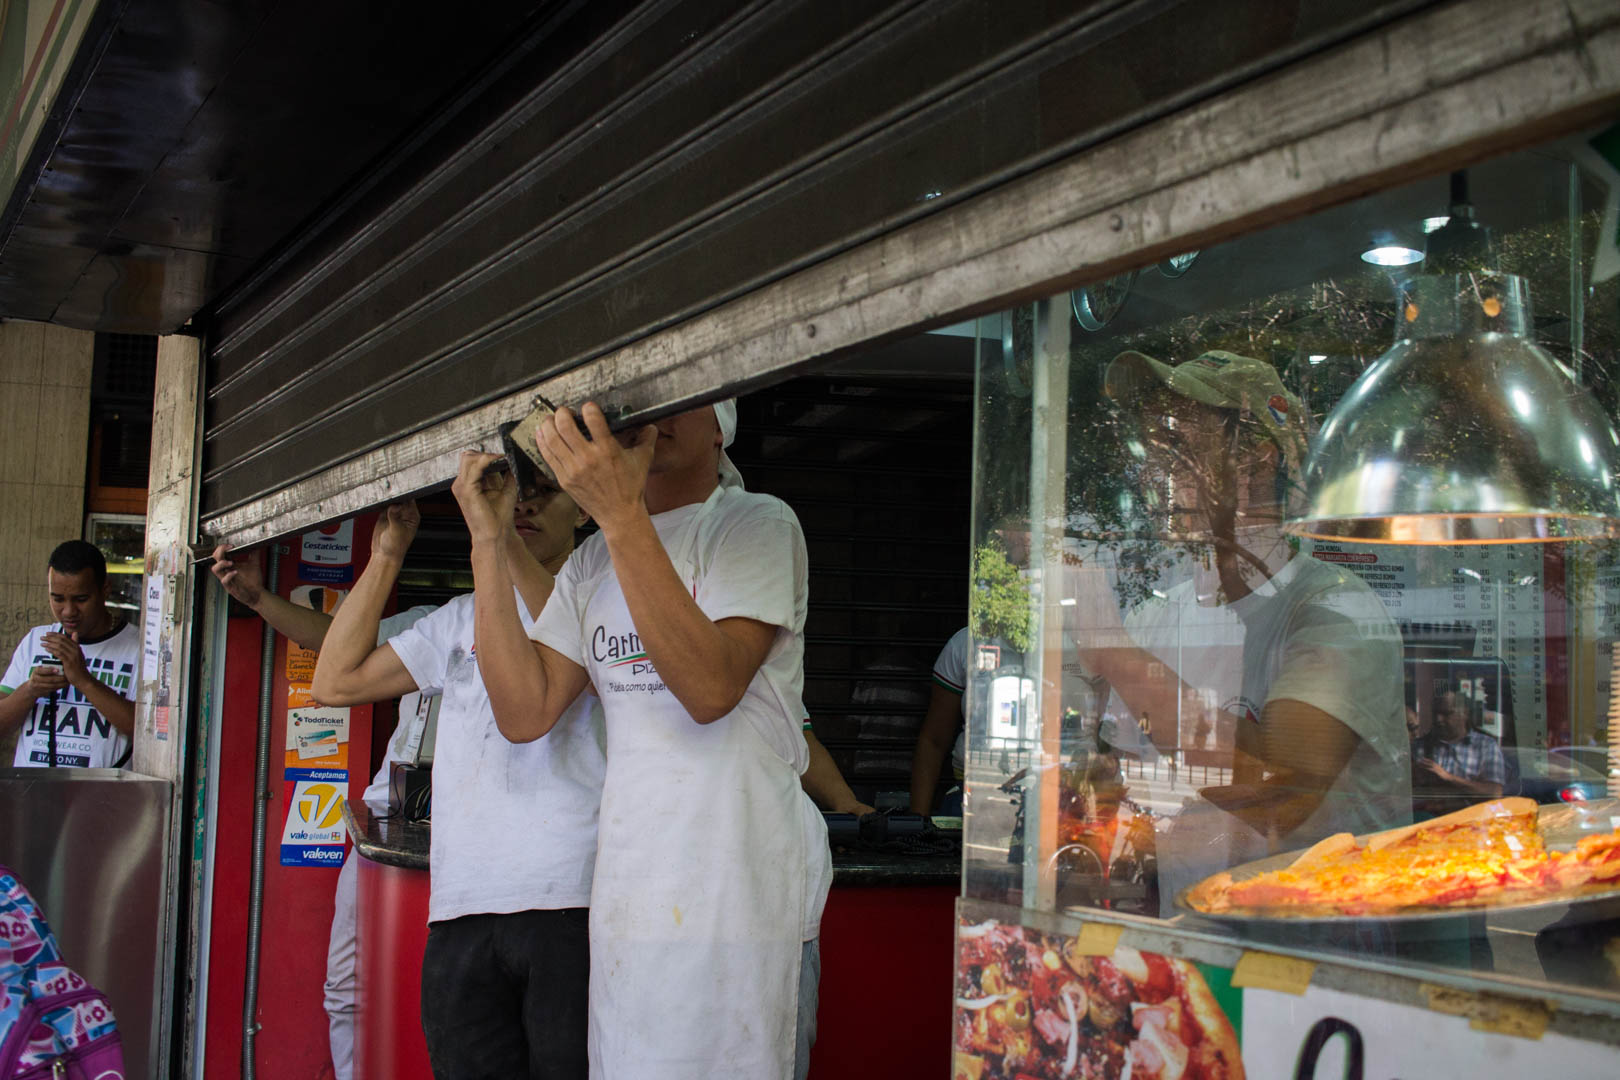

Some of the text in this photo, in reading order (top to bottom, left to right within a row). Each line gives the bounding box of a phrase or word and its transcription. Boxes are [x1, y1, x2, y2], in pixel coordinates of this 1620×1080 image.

[303, 542, 350, 551] Cestaticket
[592, 625, 646, 662] Carn
[625, 683, 647, 692] como
[37, 753, 48, 761] BY
[309, 770, 347, 780] Aceptamos
[290, 830, 330, 841] vale global
[303, 848, 343, 860] valeven
